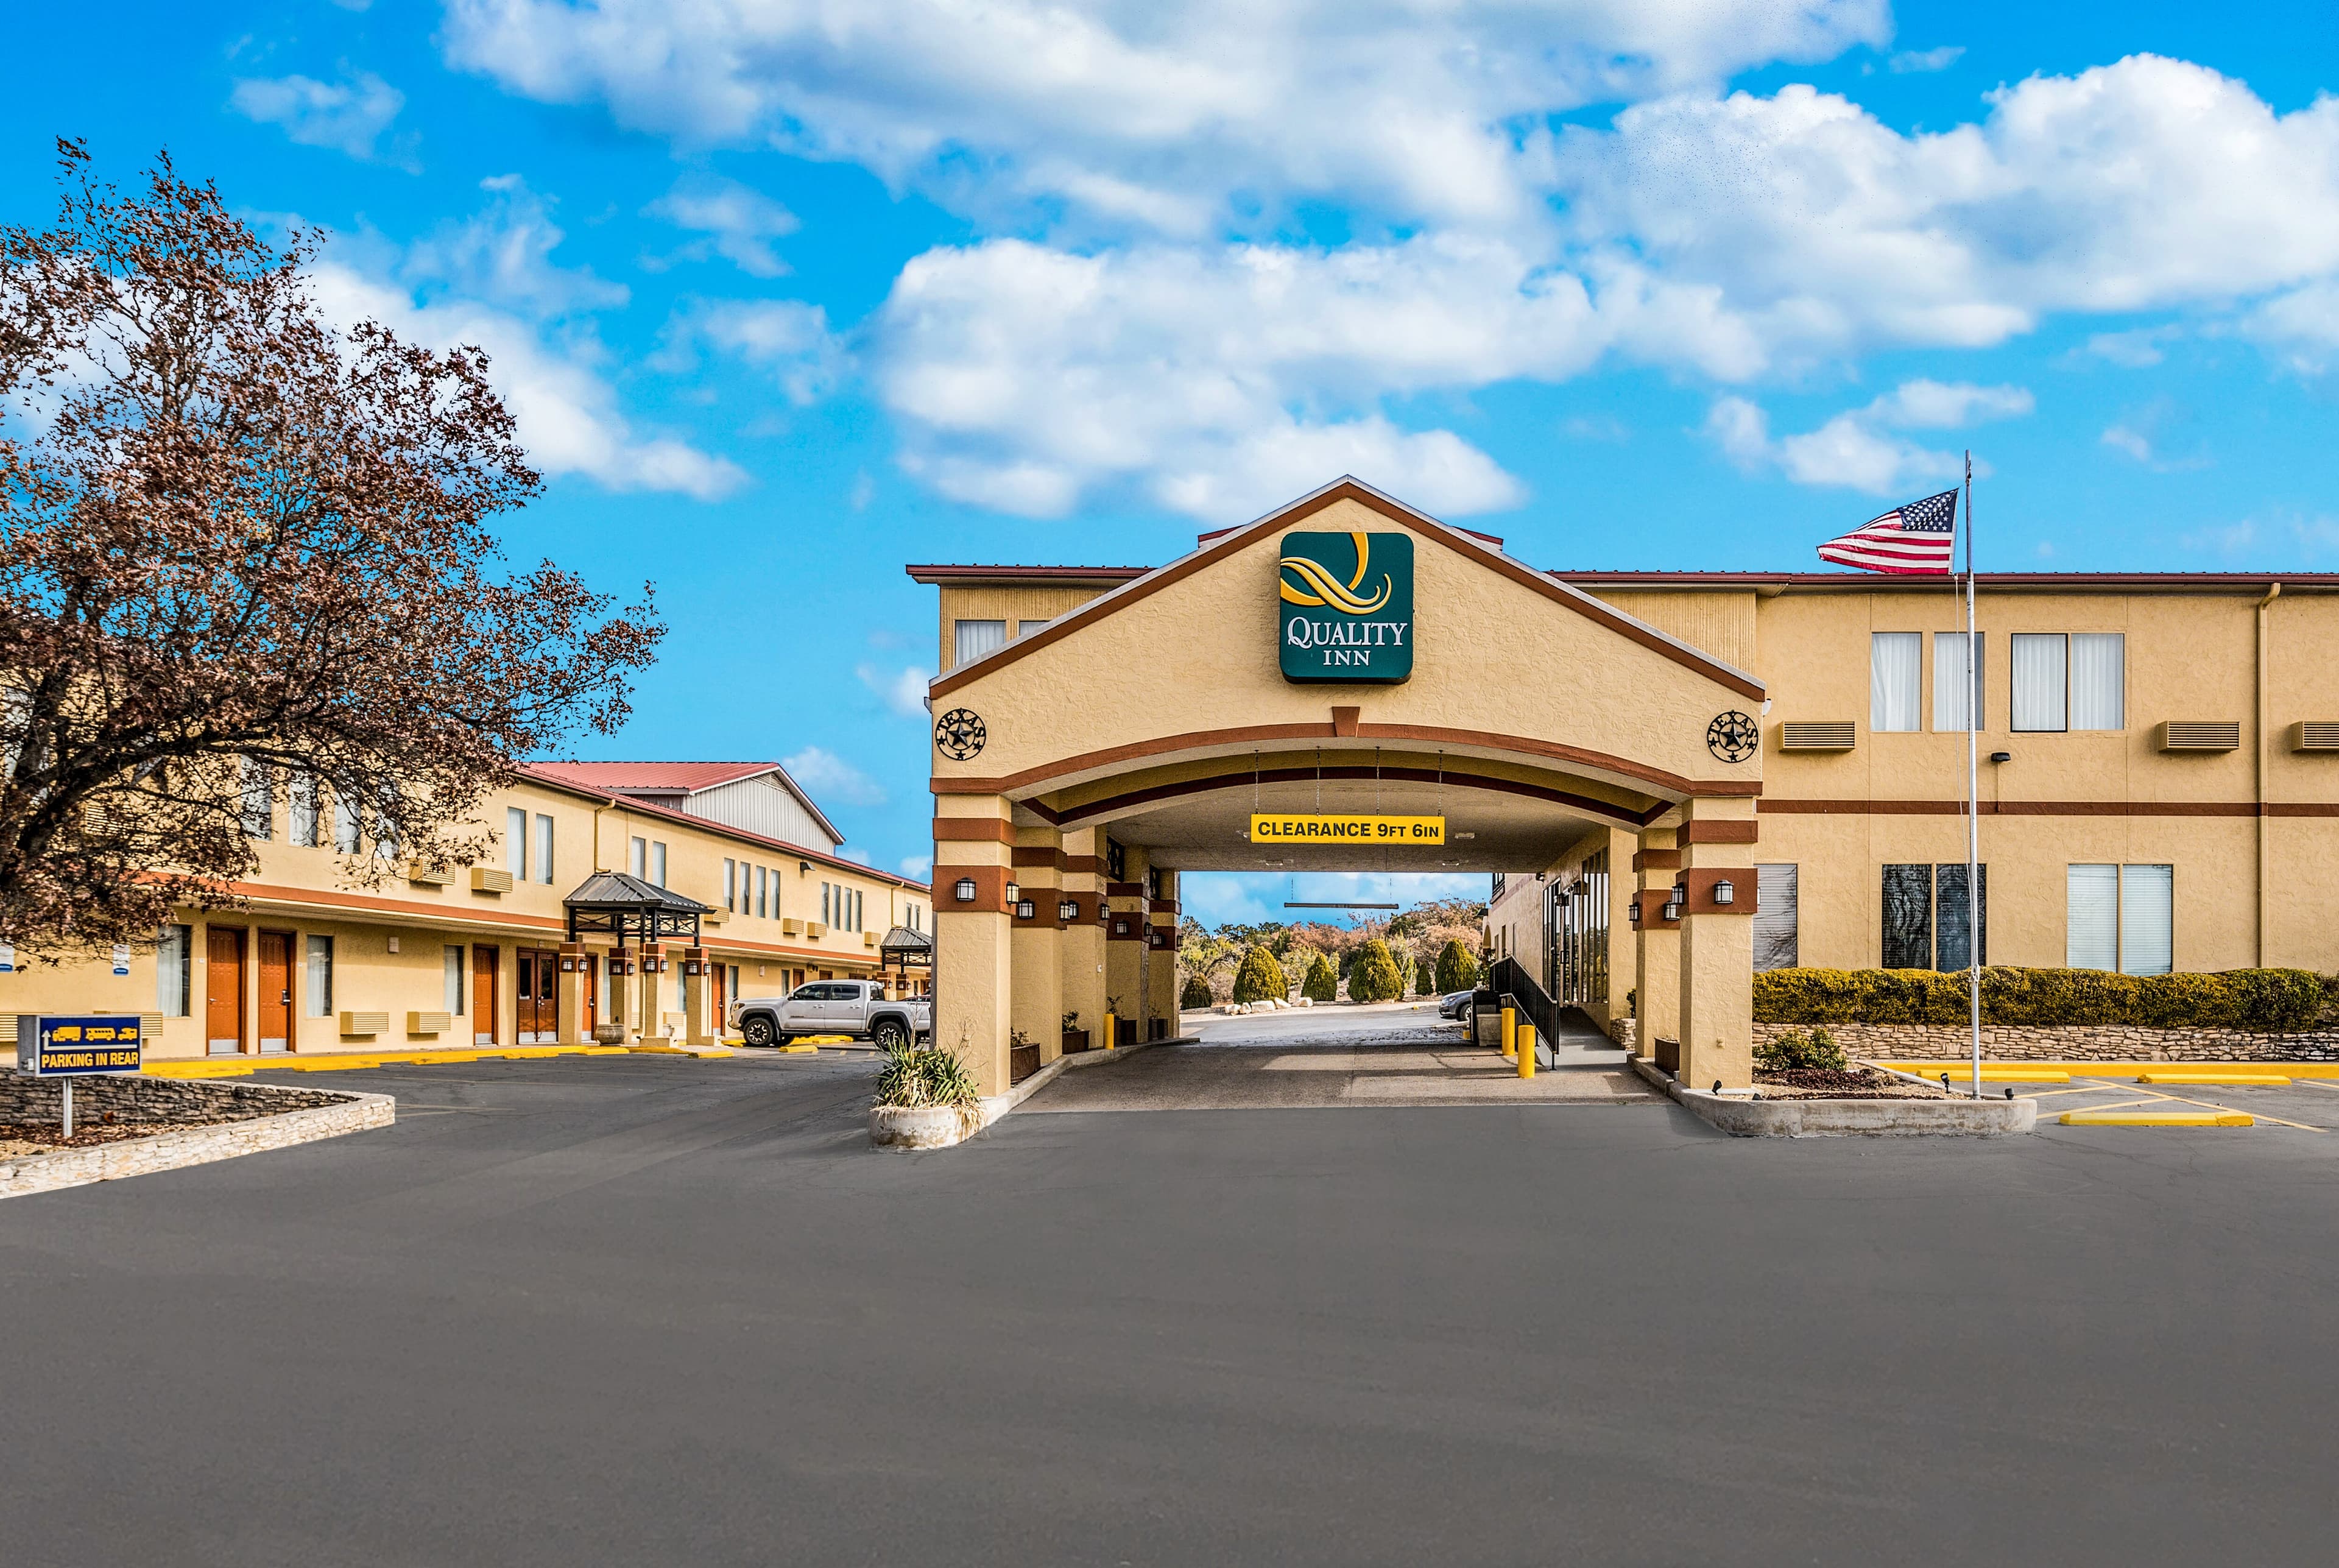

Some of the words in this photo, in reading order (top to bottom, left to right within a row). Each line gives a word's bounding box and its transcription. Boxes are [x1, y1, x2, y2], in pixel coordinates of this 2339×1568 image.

[1287, 616, 1408, 649] QUALITY
[1323, 650, 1371, 666] INN
[937, 709, 986, 738] TEXAS
[1708, 712, 1758, 738] TEXAS
[1258, 822, 1371, 837] CLEARANCE
[1377, 823, 1406, 838] 9FT
[1412, 823, 1439, 838] 6IN
[41, 1053, 93, 1068] PARKING
[96, 1053, 108, 1066] IN
[110, 1052, 138, 1065] REAR
